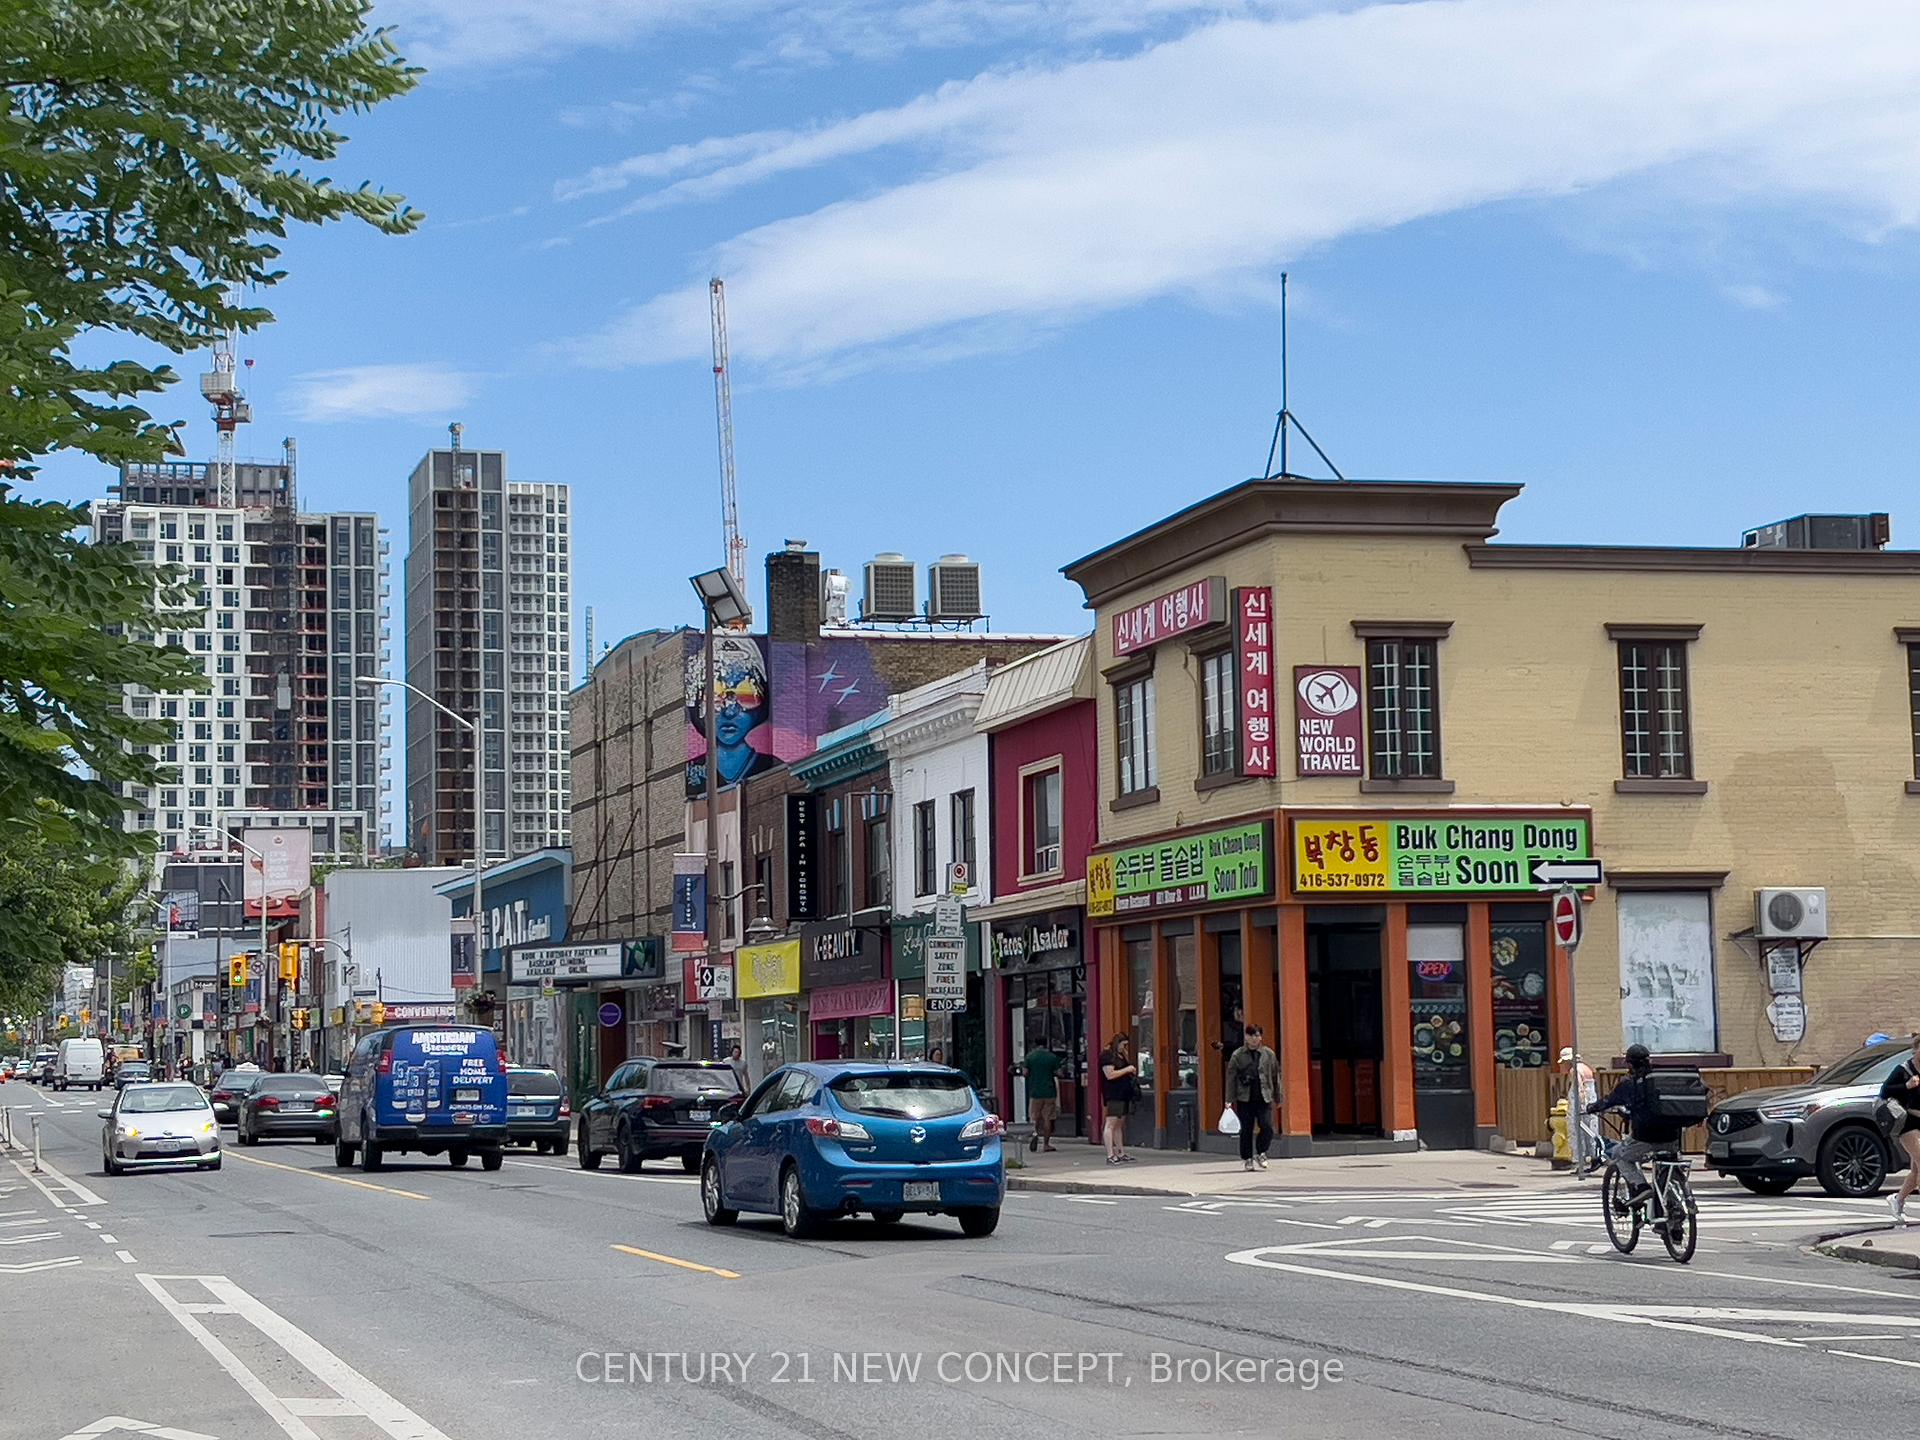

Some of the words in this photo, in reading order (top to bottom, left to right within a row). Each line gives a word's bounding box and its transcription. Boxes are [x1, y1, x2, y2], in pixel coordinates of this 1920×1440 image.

[1117, 600, 1157, 650] 신세계
[1161, 583, 1204, 631] 여행사
[1245, 593, 1268, 676] 신세계
[1247, 688, 1270, 771] 여행사
[1300, 719, 1334, 735] NEW
[1300, 736, 1356, 752] WORLD
[1301, 754, 1361, 771] TRAVEL
[1396, 825, 1438, 850] Buk
[1446, 825, 1514, 852] Chang
[1523, 824, 1577, 852] Dong
[1304, 825, 1380, 870] 북창동
[1397, 854, 1451, 869] 순두부
[1115, 851, 1155, 889] 순두부
[1456, 855, 1519, 885] Soon
[1214, 866, 1237, 894] Soon
[1300, 873, 1385, 888] 416-537-0972
[929, 940, 964, 949] COMMUNITY
[1032, 924, 1070, 952] Asador
[934, 952, 958, 960] SAFETY
[937, 963, 954, 971] ZONE
[1418, 962, 1450, 976] OPEN
[936, 975, 956, 984] FINES
[931, 999, 960, 1010] ENDS
[412, 1032, 476, 1044] AMSTERDAM
[462, 1059, 484, 1067] FREE
[460, 1068, 487, 1076] HOME
[452, 1076, 494, 1085] DELIVERY
